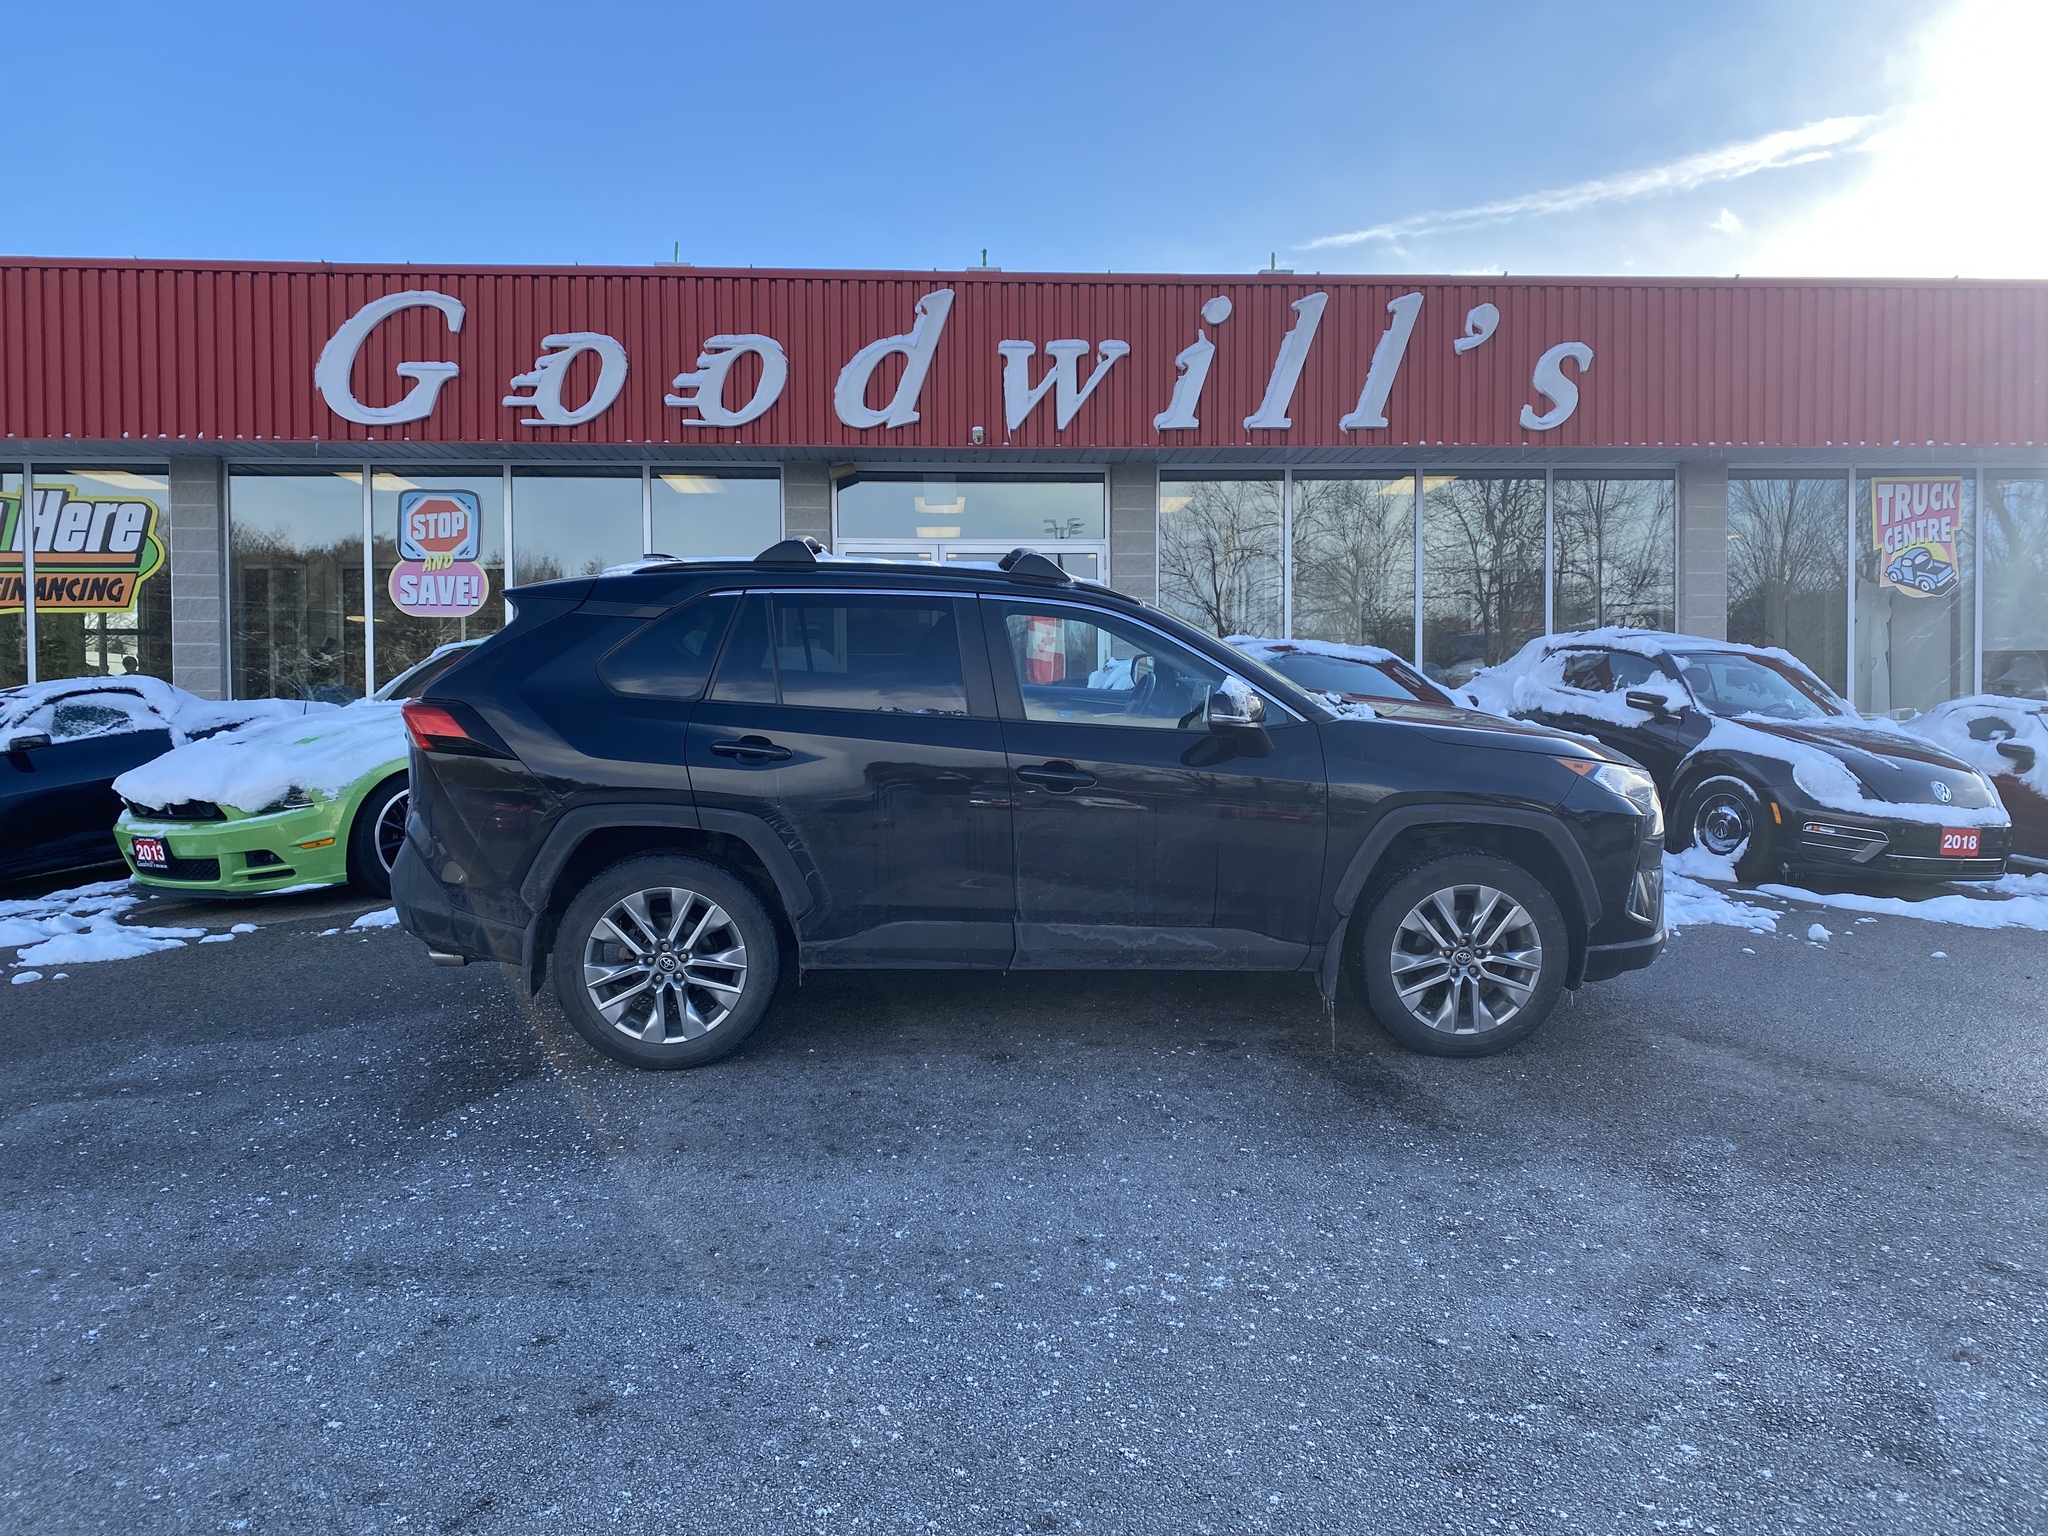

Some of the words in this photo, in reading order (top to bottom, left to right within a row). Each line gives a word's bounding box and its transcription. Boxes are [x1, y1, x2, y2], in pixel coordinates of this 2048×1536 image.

[315, 288, 1594, 432] Goodwill's
[1877, 483, 1957, 526] TRUCK
[12, 491, 147, 553] Here
[411, 511, 465, 541] STOP
[1884, 516, 1952, 554] CENTRE
[422, 552, 454, 572] AND
[400, 574, 479, 606] SAVE!
[136, 844, 165, 861] 2013
[1943, 834, 1978, 850] 2018
